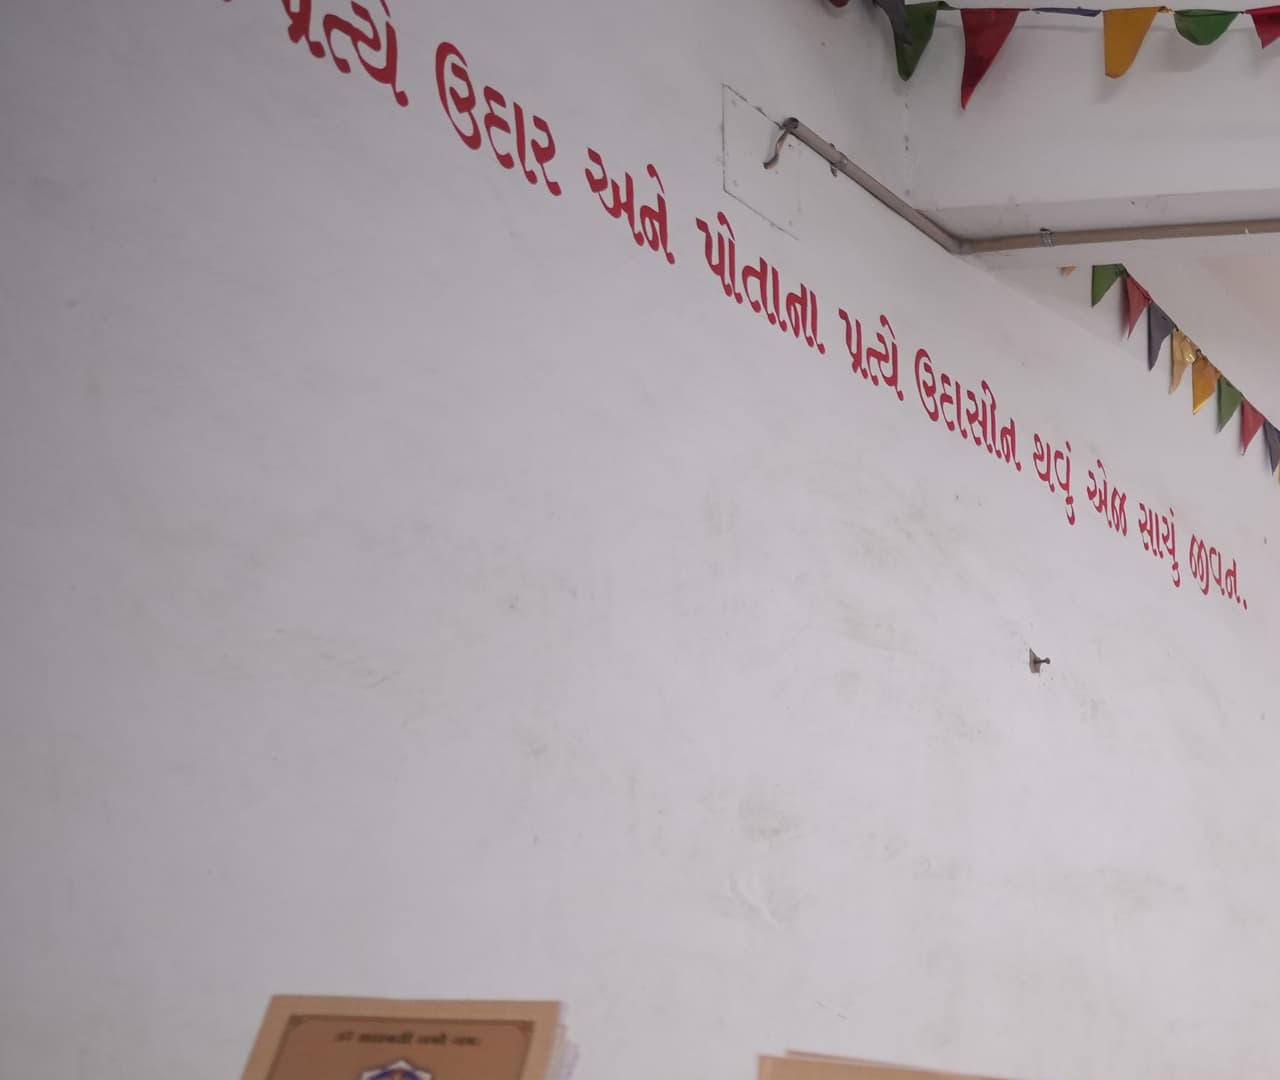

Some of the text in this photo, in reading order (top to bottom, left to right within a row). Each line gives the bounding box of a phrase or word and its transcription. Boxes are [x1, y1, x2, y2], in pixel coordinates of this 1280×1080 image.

[435, 42, 561, 196] ઉદાર
[585, 148, 675, 264] અને
[696, 212, 826, 353] પોતાના
[839, 309, 904, 400] પ્રત્યે
[1033, 434, 1076, 525] થવું
[1087, 460, 1128, 535] એજ
[1138, 503, 1181, 587] સાચું
